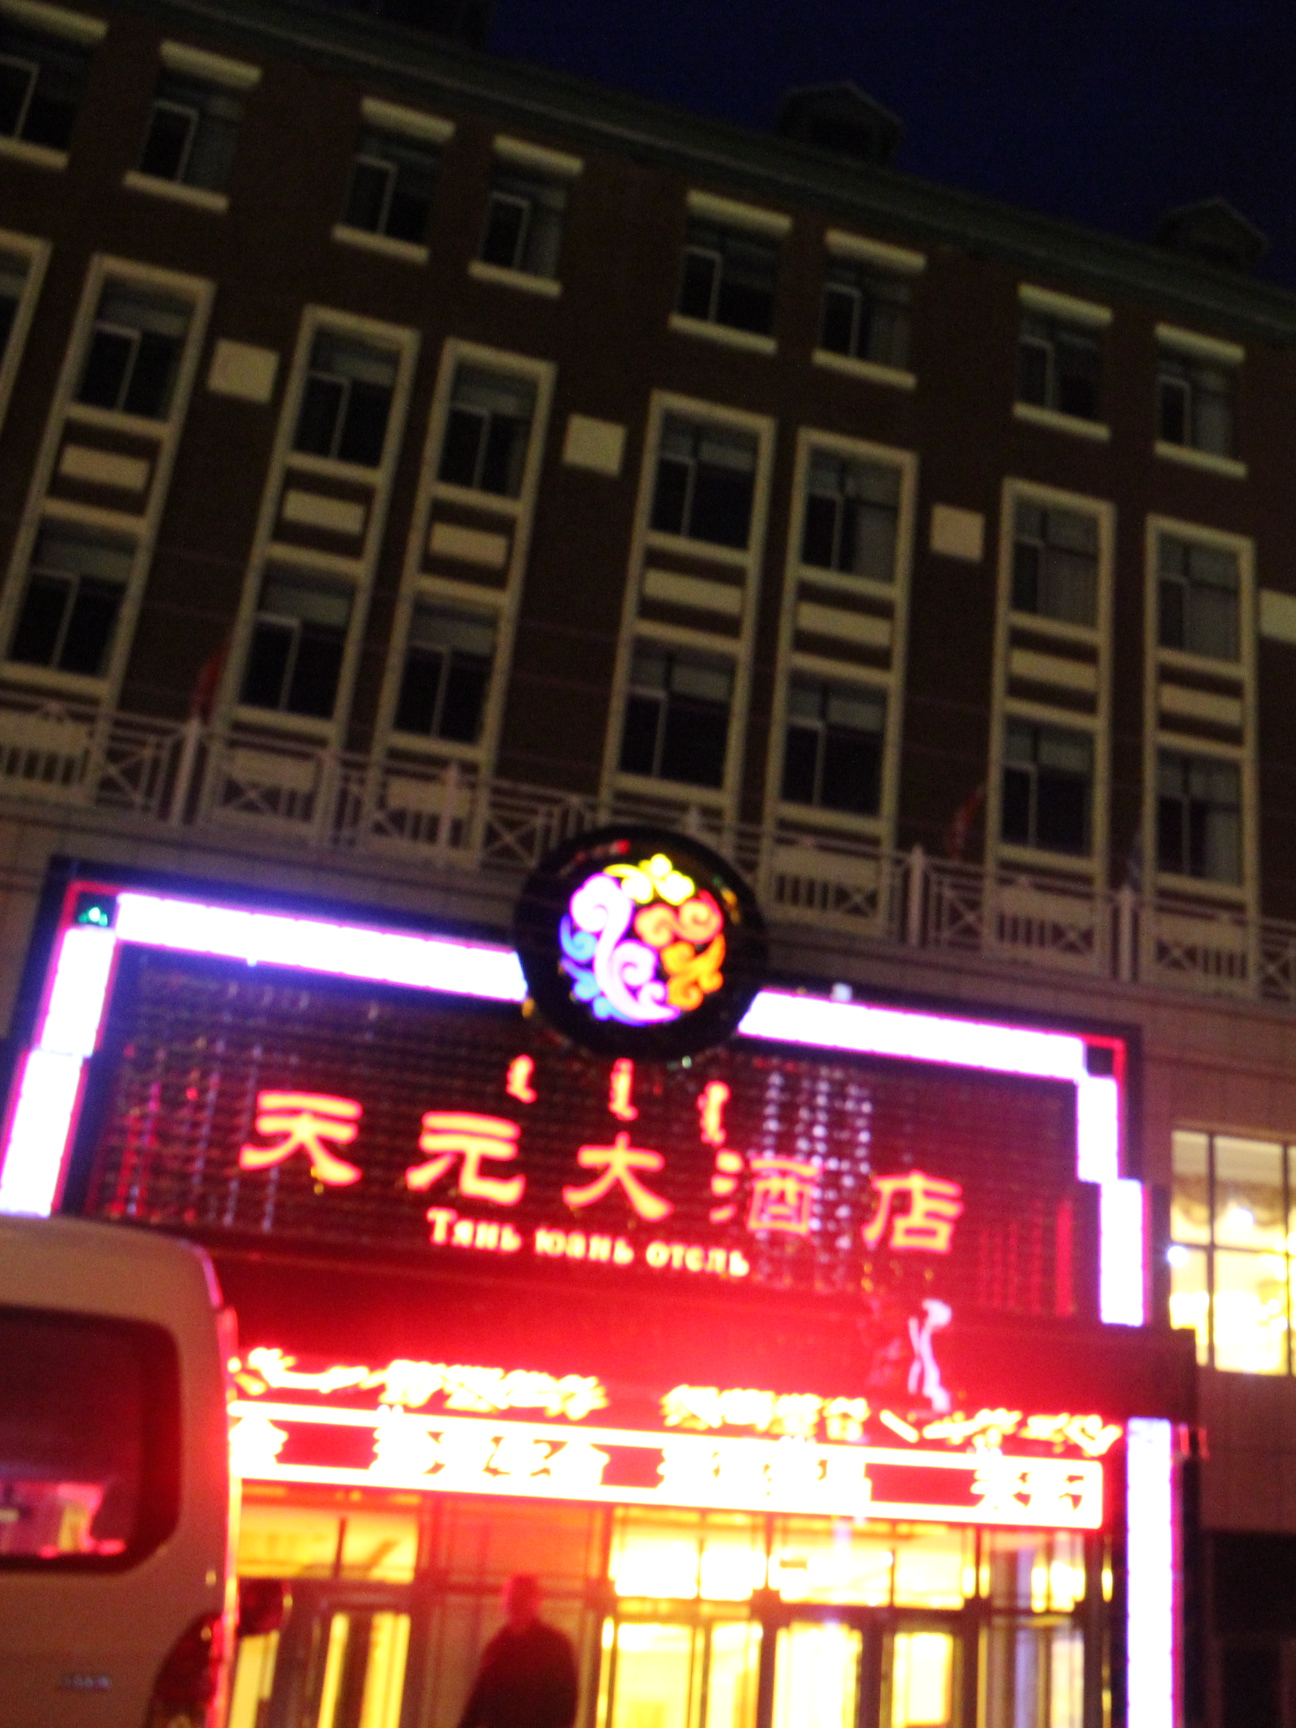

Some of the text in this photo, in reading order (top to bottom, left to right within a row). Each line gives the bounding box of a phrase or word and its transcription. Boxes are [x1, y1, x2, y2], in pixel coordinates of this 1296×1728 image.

[238, 1090, 963, 1254] 天元大酒店
